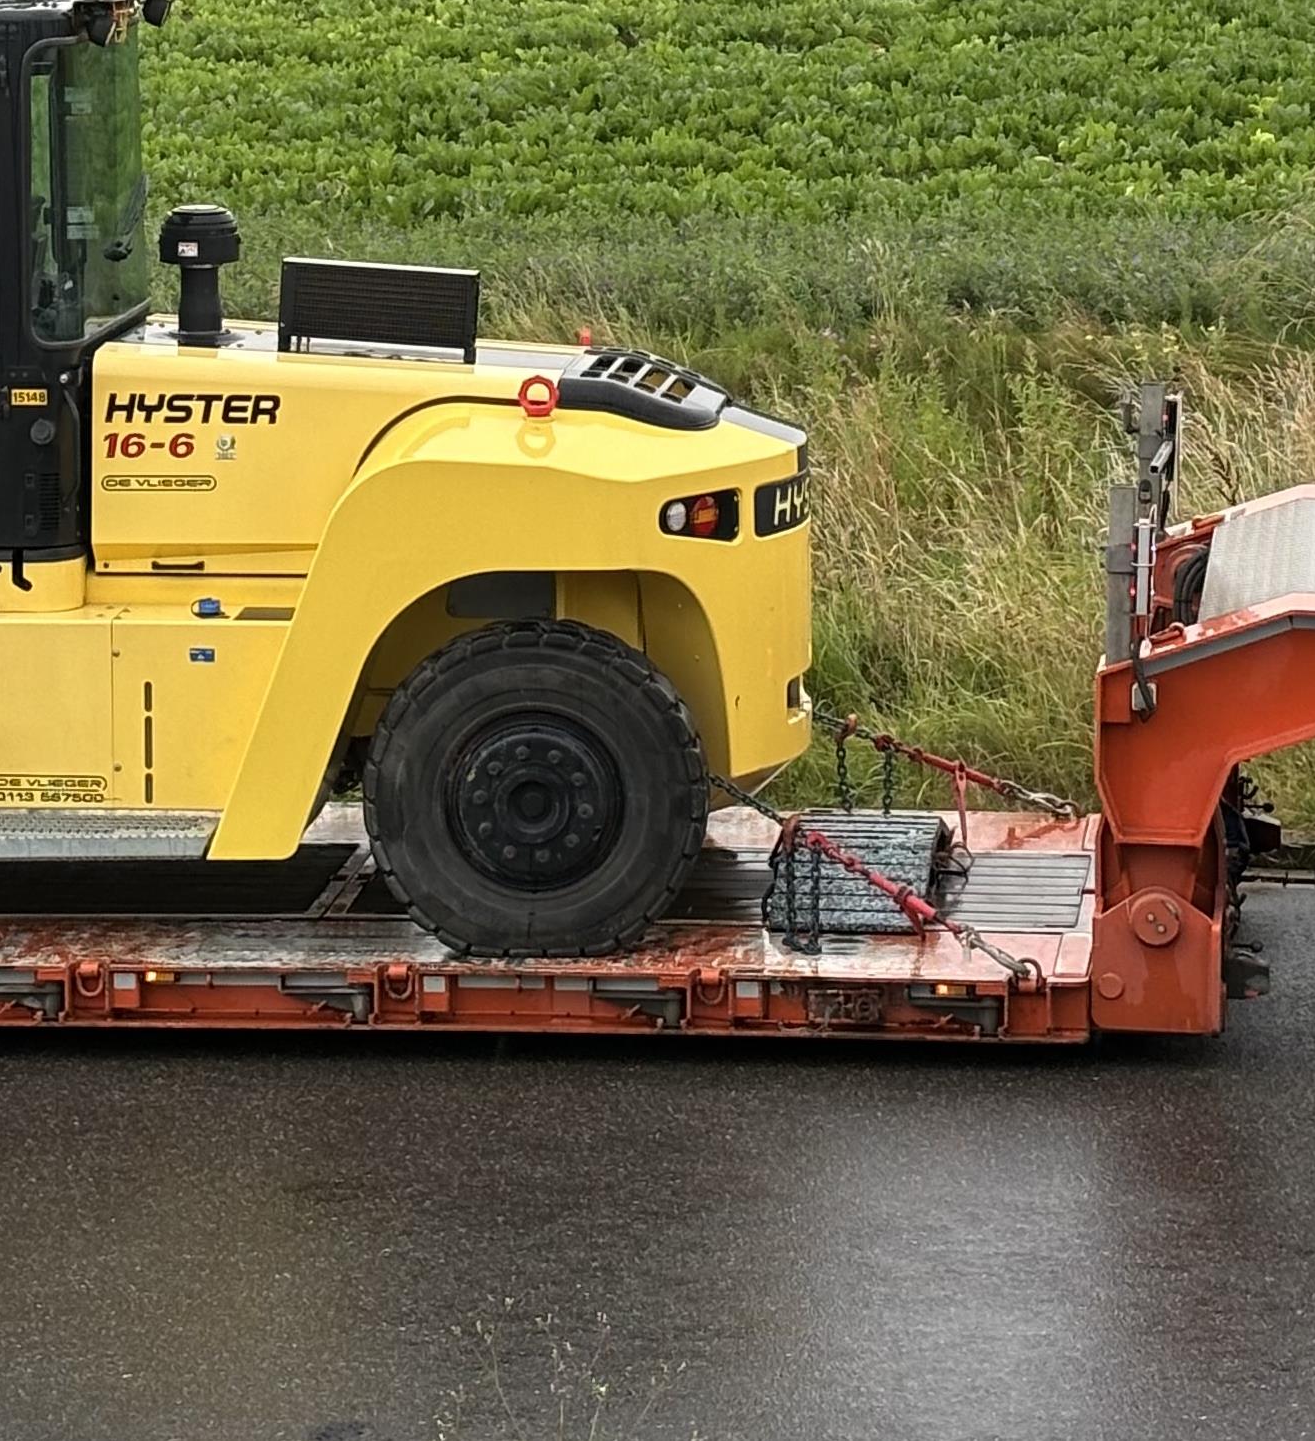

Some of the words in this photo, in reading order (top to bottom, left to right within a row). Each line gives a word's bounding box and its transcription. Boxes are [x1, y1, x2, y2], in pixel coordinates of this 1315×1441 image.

[13, 391, 46, 403] 15148
[104, 393, 281, 425] HYSTER
[103, 432, 196, 459] 16-6
[105, 479, 131, 487] DE
